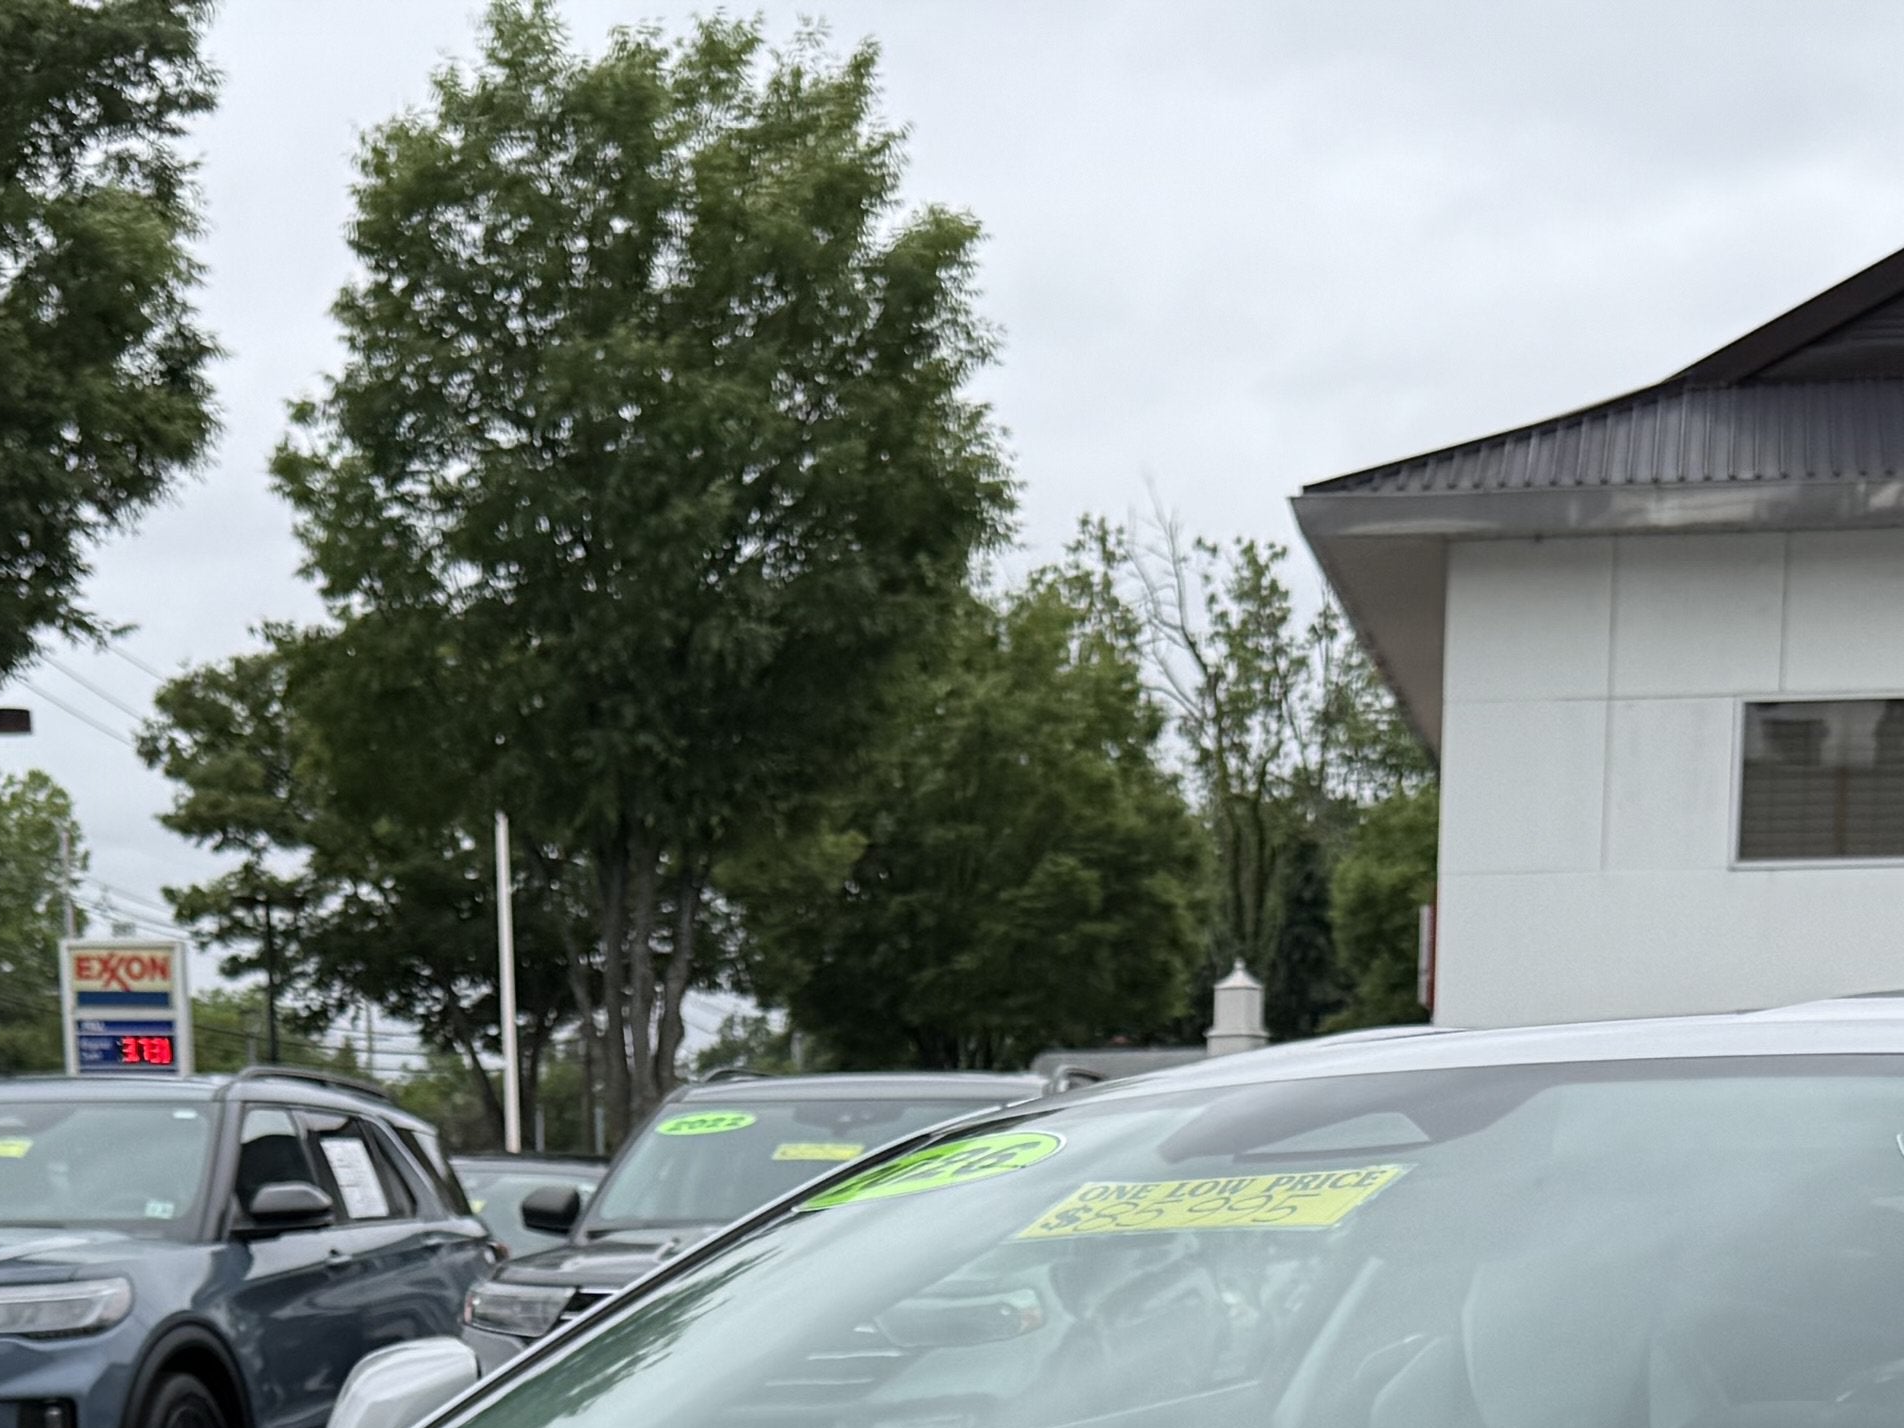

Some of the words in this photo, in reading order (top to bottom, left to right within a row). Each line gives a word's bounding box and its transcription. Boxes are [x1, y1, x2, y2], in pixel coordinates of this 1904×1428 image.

[74, 952, 171, 992] EXXON
[1077, 1183, 1161, 1202] ONE
[1164, 1176, 1250, 1200] LOW
[1262, 1168, 1388, 1195] PRICE
